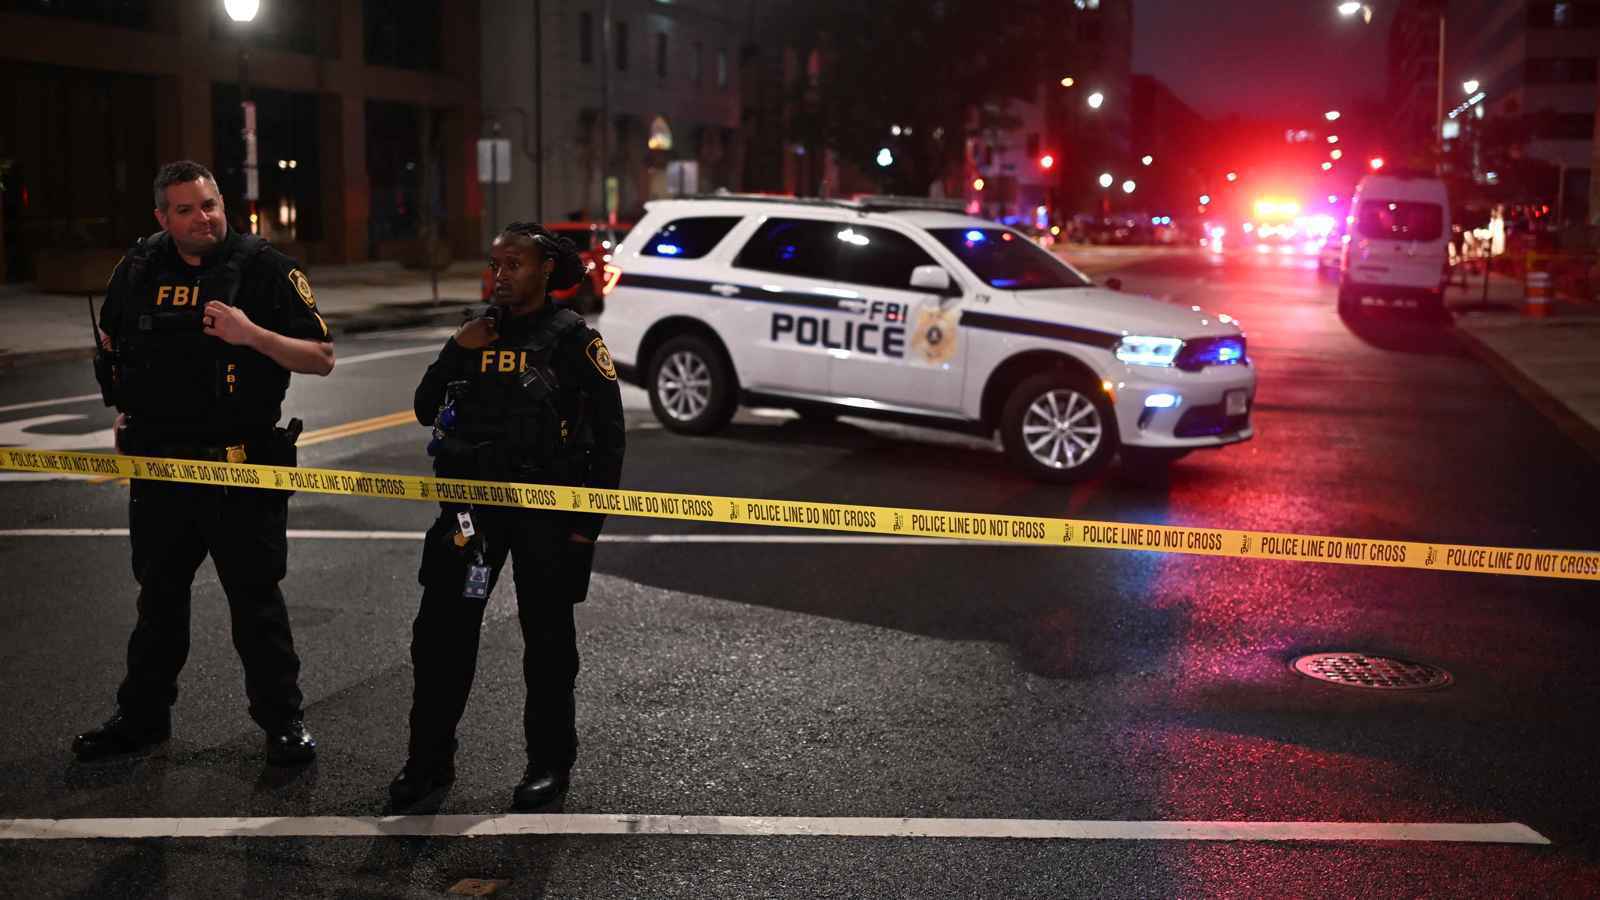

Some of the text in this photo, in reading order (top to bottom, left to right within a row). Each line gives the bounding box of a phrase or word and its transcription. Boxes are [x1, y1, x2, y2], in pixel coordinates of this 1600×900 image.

[156, 286, 200, 306] FBI
[869, 301, 908, 324] FBI
[771, 313, 906, 358] POLICE
[480, 351, 527, 373] FBI
[226, 363, 236, 393] FBI
[146, 462, 177, 478] POLICE
[177, 464, 198, 480] LINE
[199, 466, 211, 481] DO
[212, 467, 229, 482] NOT
[231, 468, 260, 484] CROSS
[289, 472, 320, 488] POLICE
[320, 474, 341, 490] LINE
[341, 476, 355, 492] DO
[356, 477, 374, 493] NOT
[375, 479, 406, 495] CROSS
[436, 482, 469, 499] POLICE
[469, 485, 490, 501] LINE
[490, 486, 505, 502] DO
[505, 487, 522, 504] NOT
[525, 489, 557, 506] CROSS
[588, 492, 621, 511] POLICE
[623, 495, 644, 512] LINE
[646, 496, 659, 513] DO
[662, 498, 679, 515] NOT
[682, 499, 713, 517] CROSS
[747, 503, 780, 521] POLICE
[783, 505, 804, 523] LINE
[806, 507, 820, 524] DO
[822, 508, 841, 526] NOT
[844, 510, 876, 528] CROSS
[912, 514, 946, 532] POLICE
[948, 516, 970, 534] LINE
[973, 518, 987, 535] DO
[989, 519, 1009, 537] NOT
[1012, 520, 1045, 539] CROSS
[1083, 525, 1118, 544] POLICE
[1121, 527, 1143, 546] LINE
[1146, 529, 1160, 547] DO
[1163, 531, 1185, 549] NOT
[1187, 532, 1222, 550] CROSS
[1261, 536, 1298, 556] POLICE
[1301, 539, 1325, 557] LINE
[1327, 541, 1342, 559] DO
[1345, 542, 1367, 560] NOT
[1370, 543, 1407, 563] CROSS
[1446, 548, 1486, 568] POLICE
[1488, 550, 1514, 569] LINE
[1515, 552, 1532, 571] DO
[1534, 554, 1559, 572] NOT
[1560, 555, 1599, 575] CROSS
